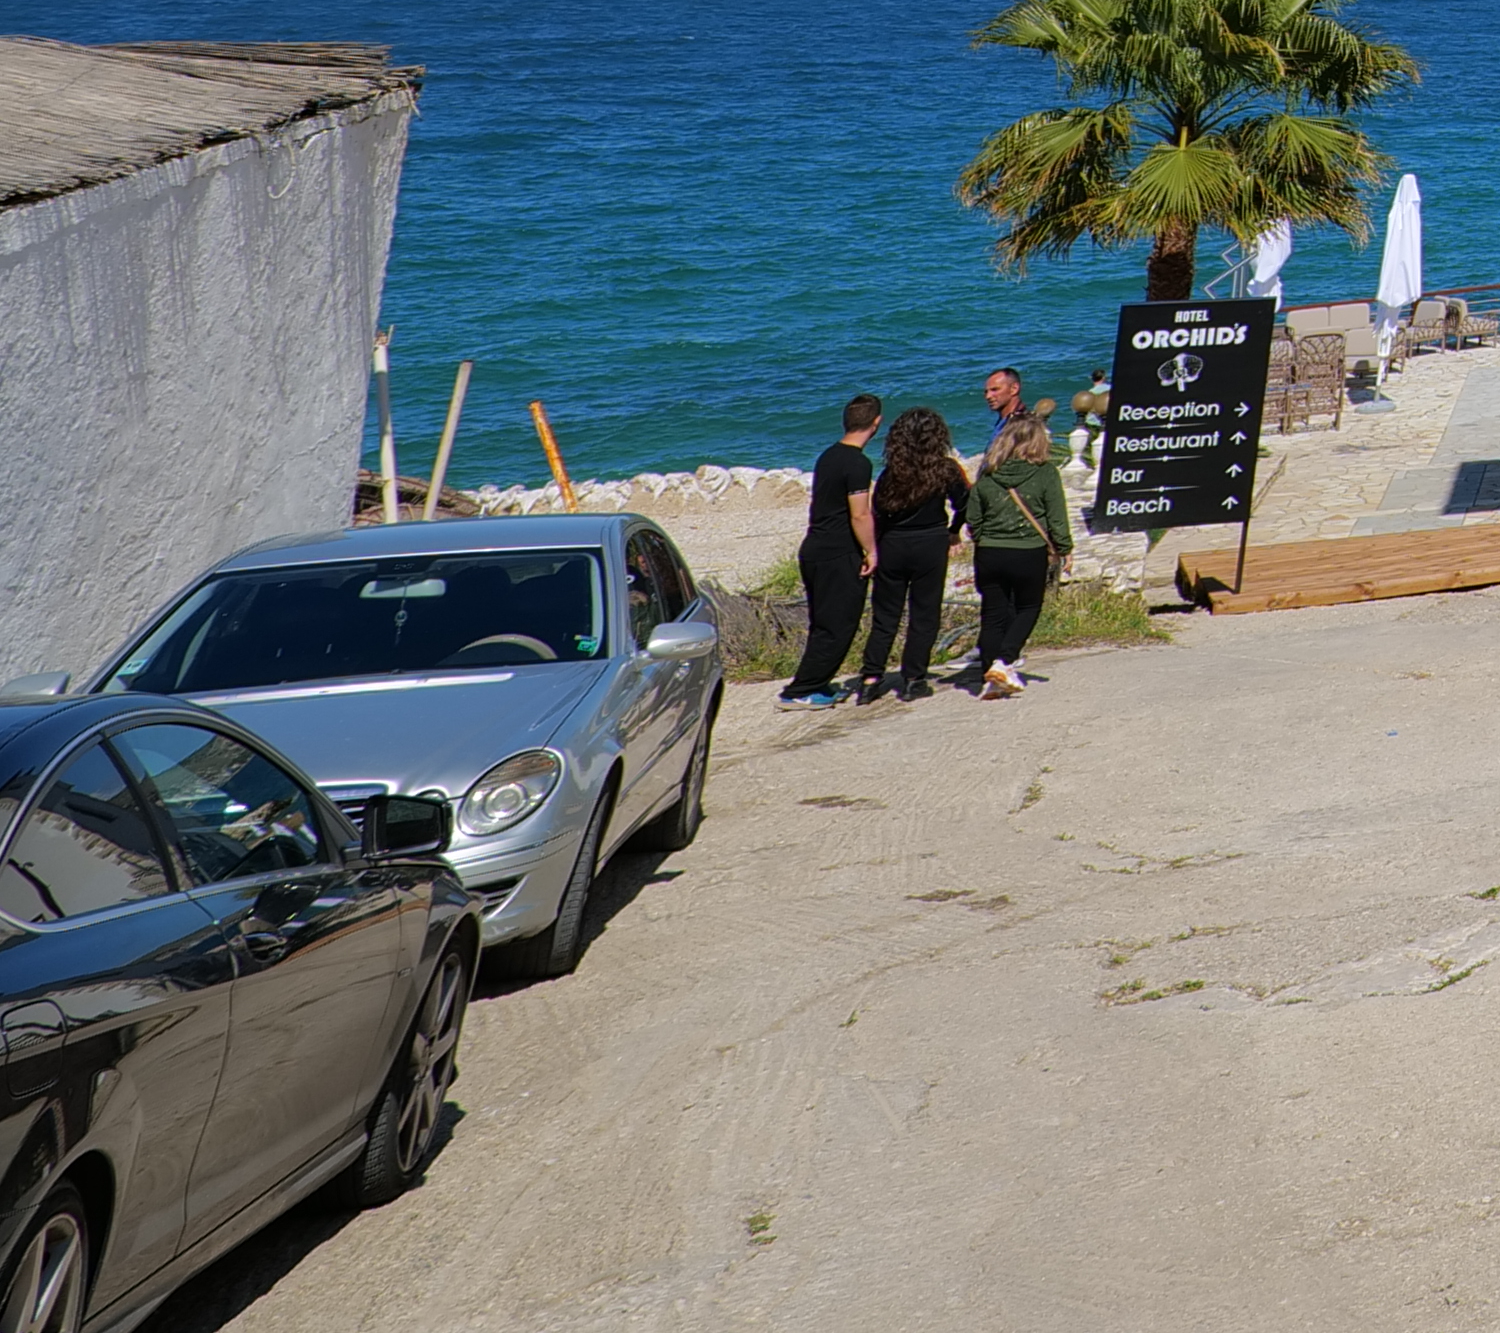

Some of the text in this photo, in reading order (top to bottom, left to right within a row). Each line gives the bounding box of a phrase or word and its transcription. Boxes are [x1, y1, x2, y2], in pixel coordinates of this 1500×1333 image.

[1174, 309, 1210, 324] HOTEL
[1131, 323, 1248, 350] ORCHID'S
[1118, 402, 1220, 421] Reception
[1114, 431, 1220, 453] Restaurant
[1110, 467, 1144, 484] Bar
[1105, 496, 1171, 516] Beach
